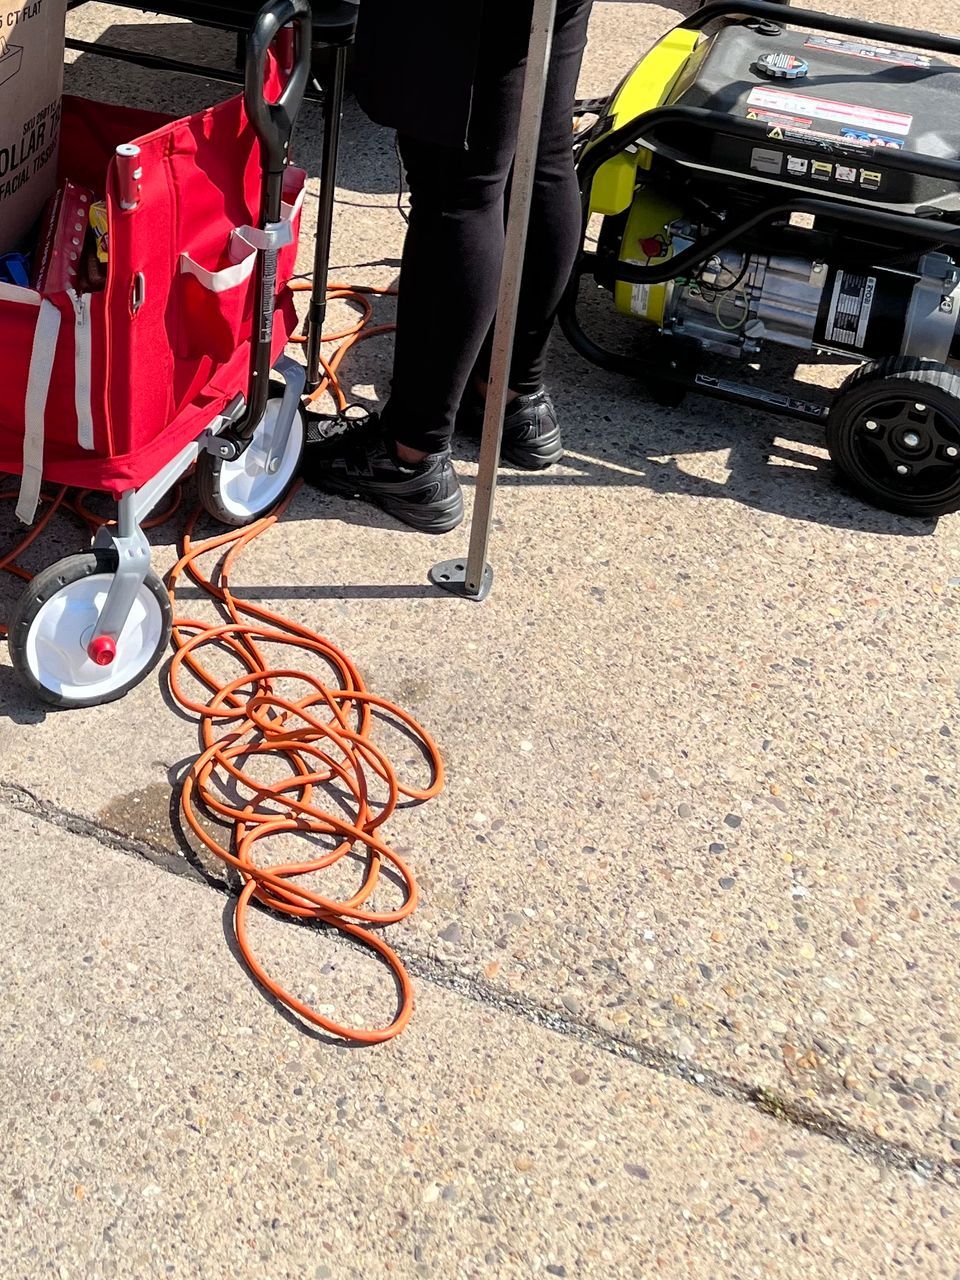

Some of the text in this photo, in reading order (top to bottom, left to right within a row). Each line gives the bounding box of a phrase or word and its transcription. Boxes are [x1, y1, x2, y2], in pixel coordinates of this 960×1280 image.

[7, 10, 21, 27] CT
[22, 0, 42, 22] FLAT
[864, 284, 874, 304] RYOBI
